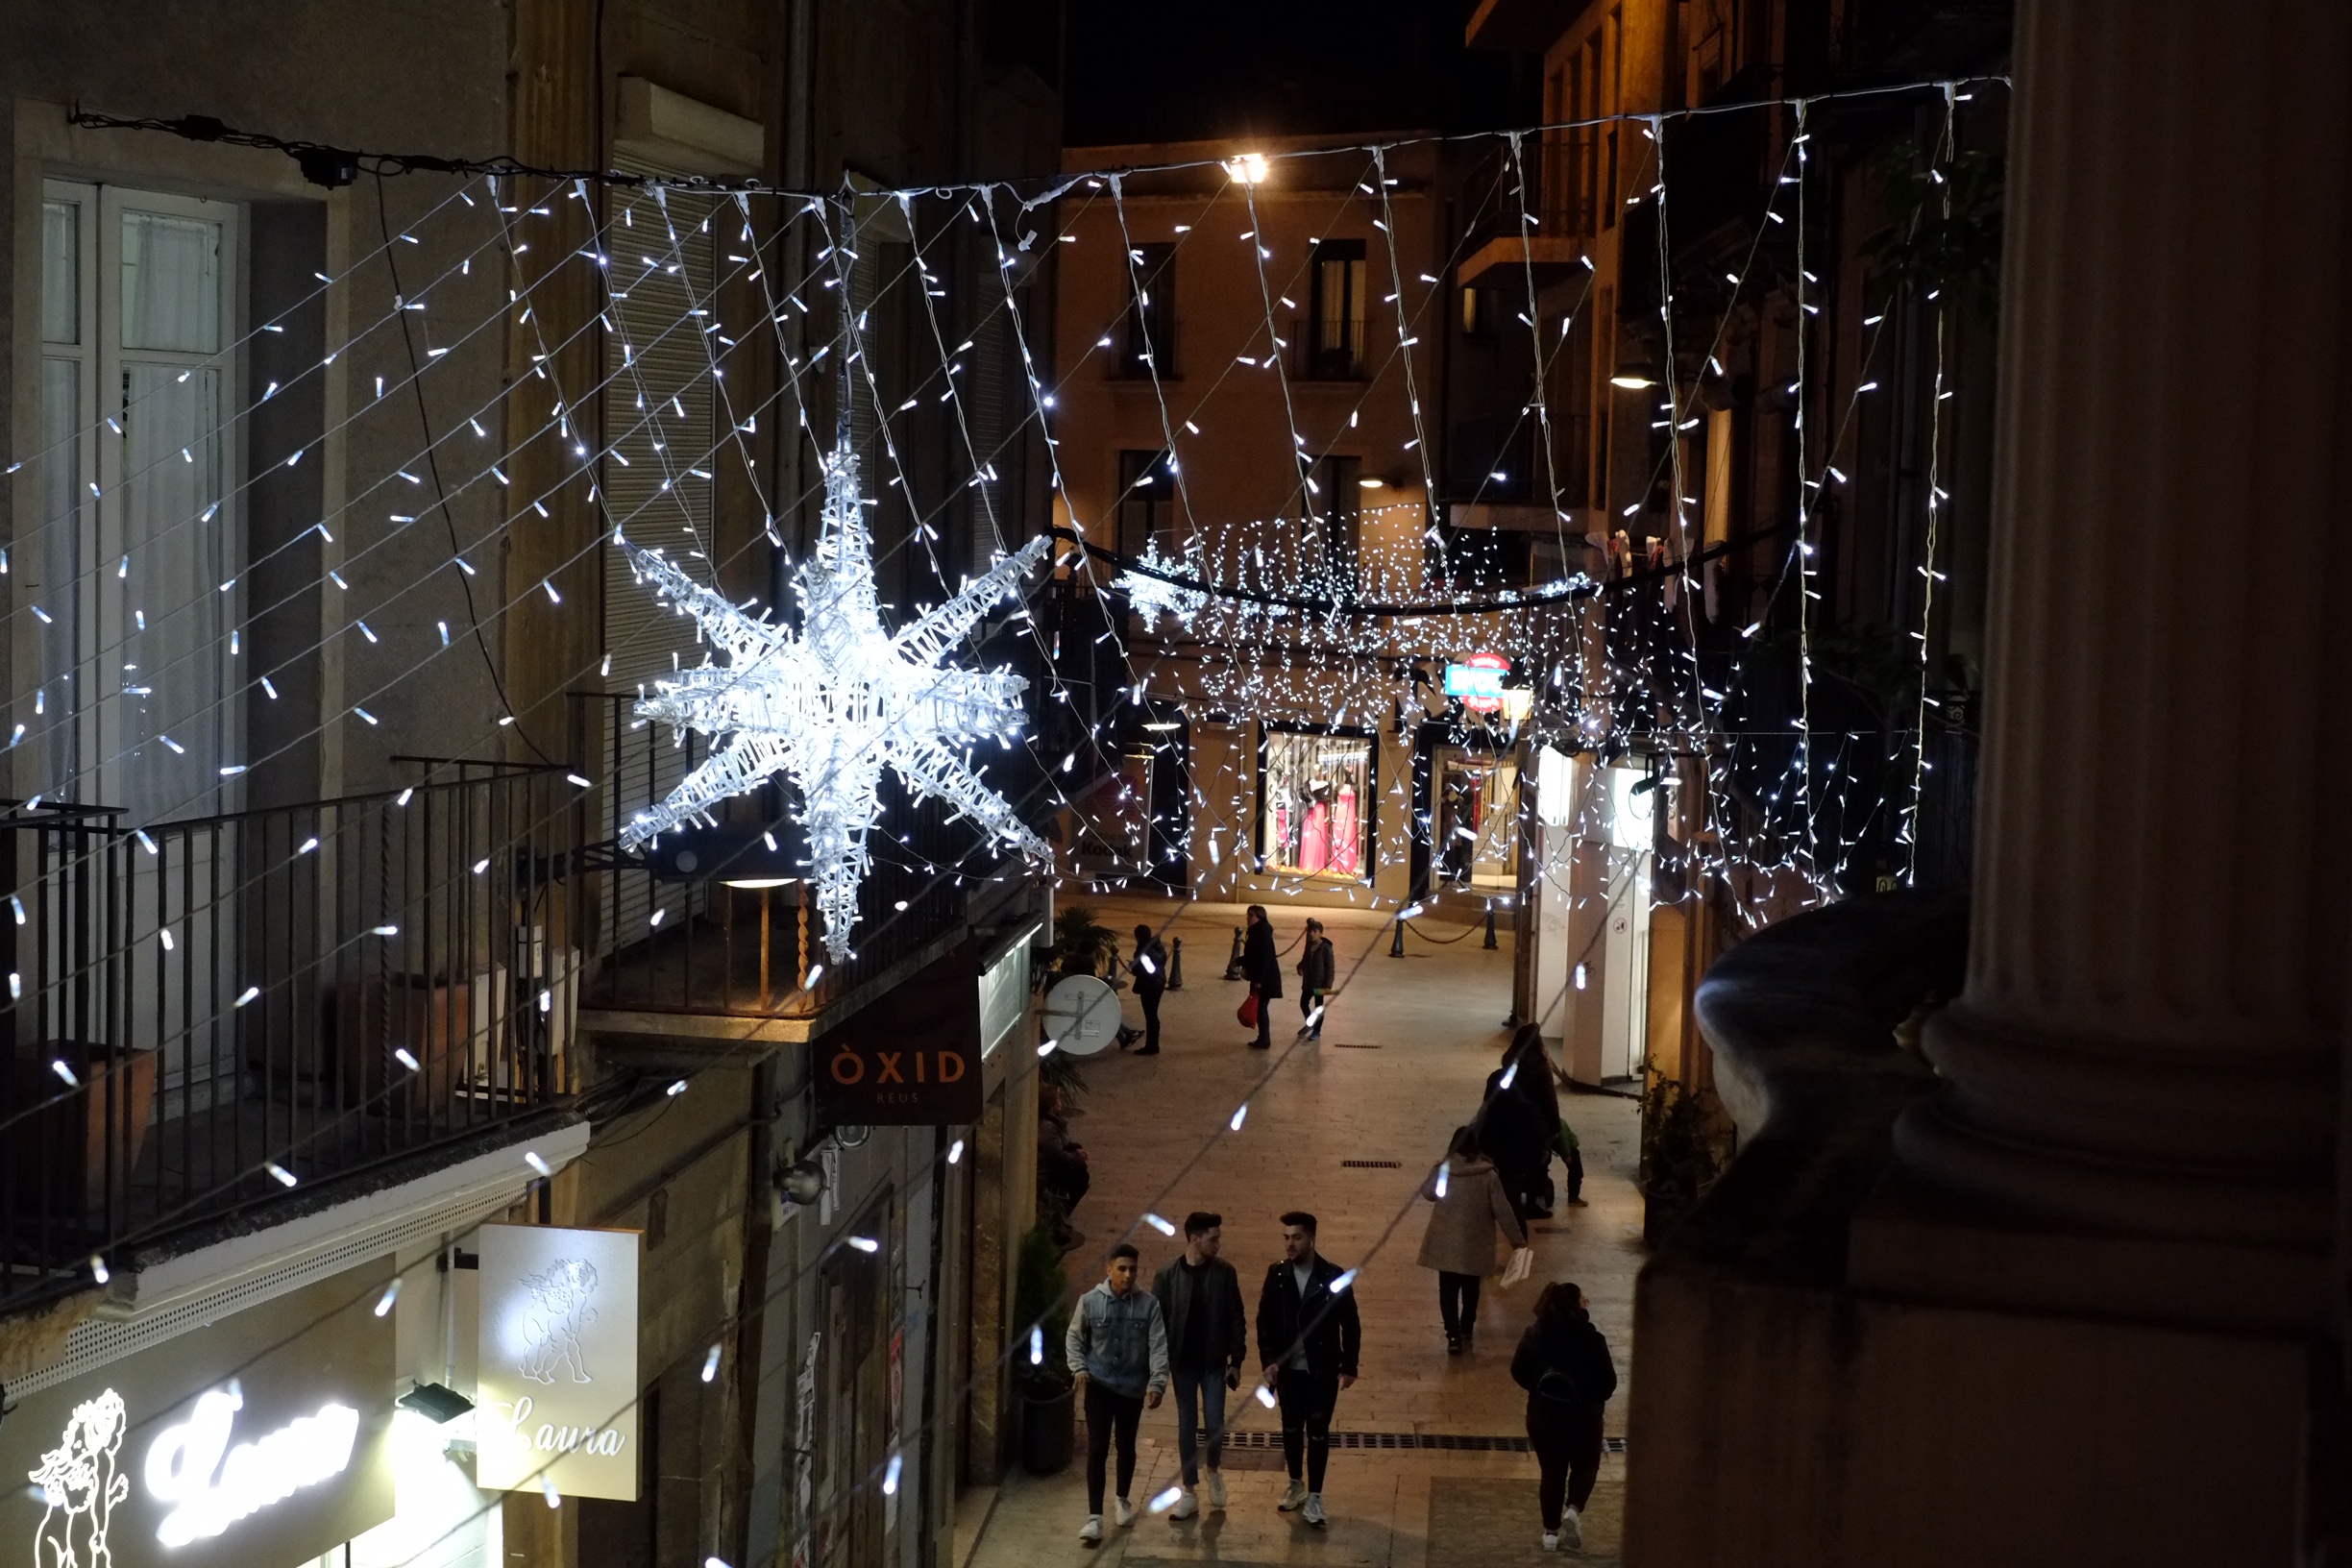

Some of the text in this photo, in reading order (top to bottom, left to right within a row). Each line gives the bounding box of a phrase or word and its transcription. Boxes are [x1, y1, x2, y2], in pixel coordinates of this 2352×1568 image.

[1081, 842, 1133, 858] Kodak
[831, 1043, 965, 1085] ÒXID
[876, 1092, 919, 1104] REUS
[487, 1395, 626, 1457] Laura
